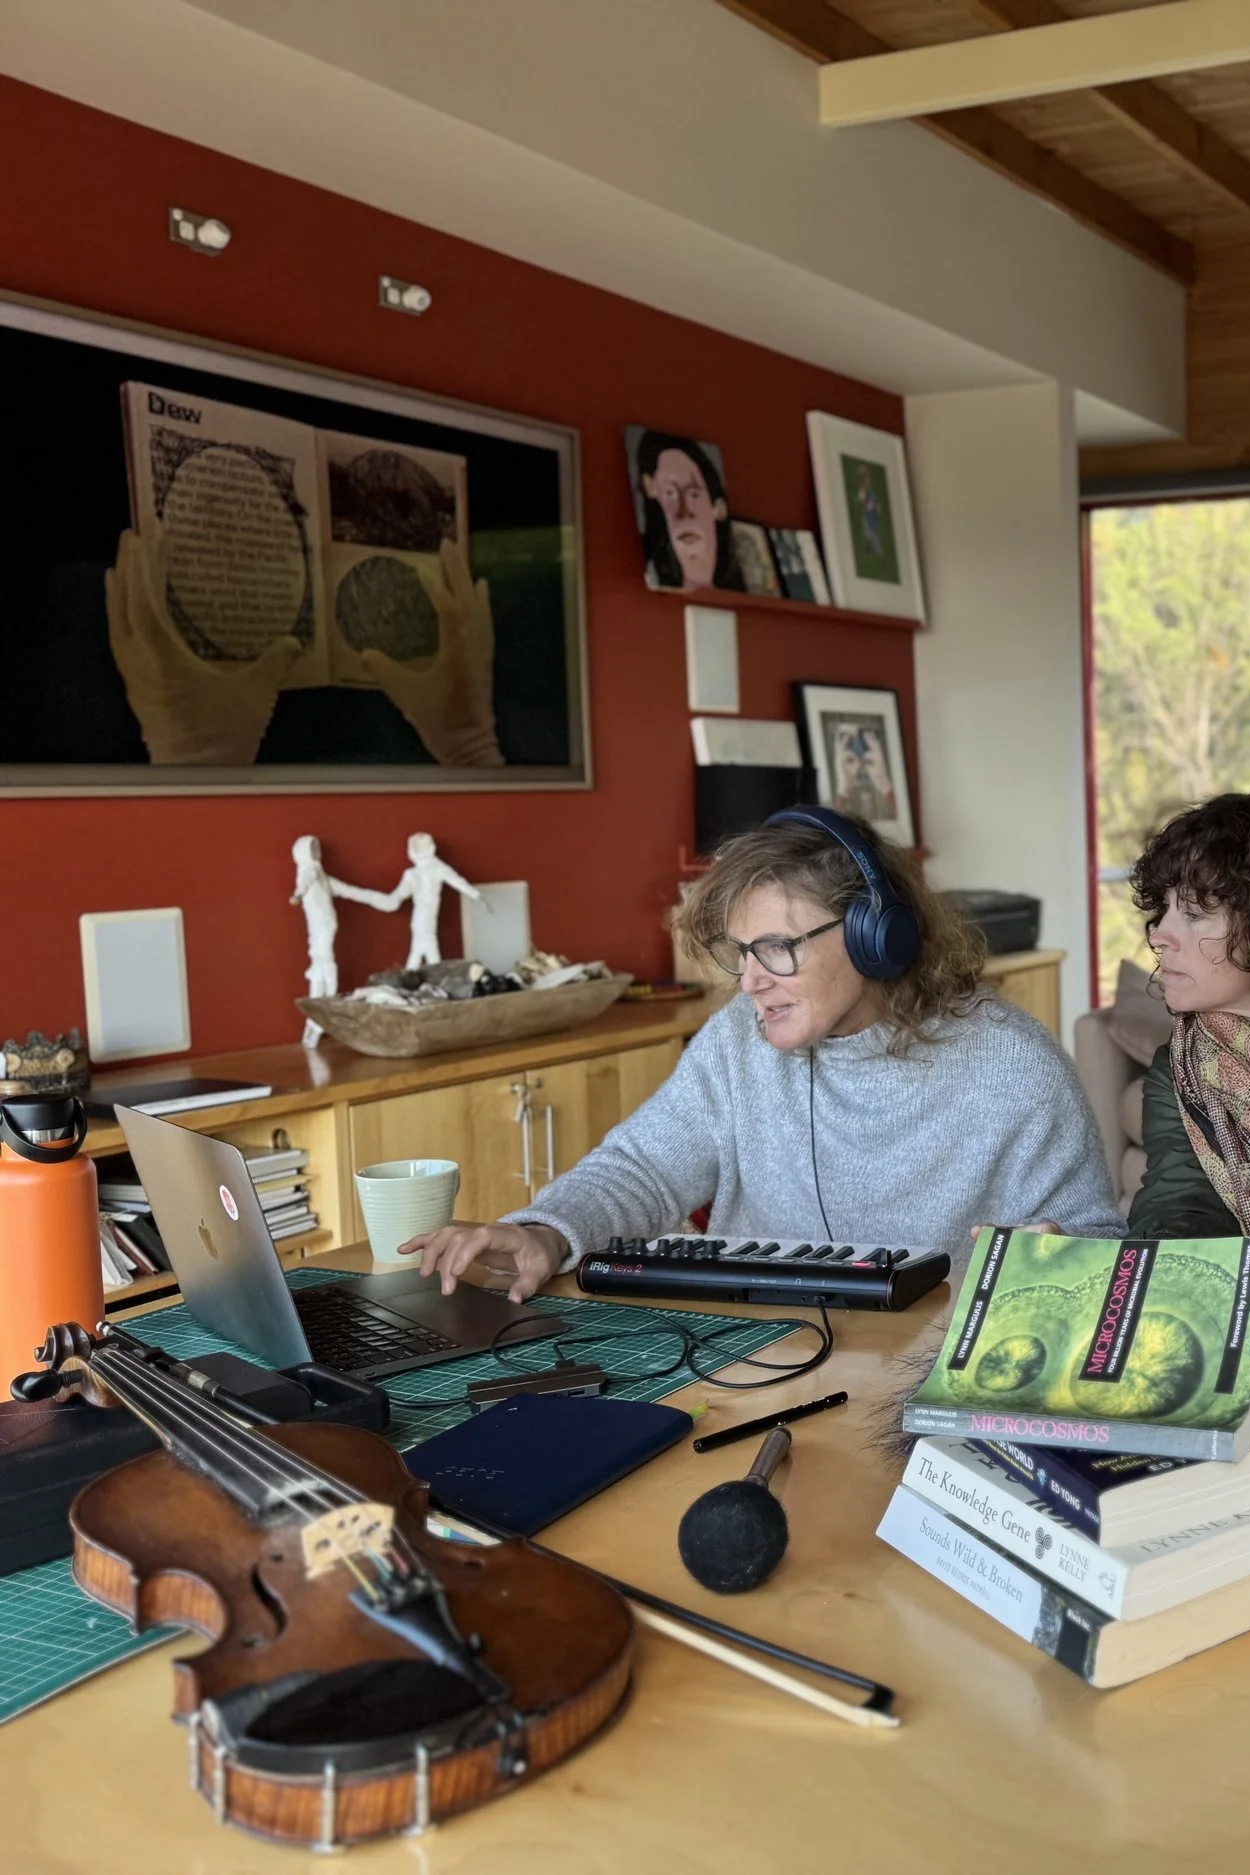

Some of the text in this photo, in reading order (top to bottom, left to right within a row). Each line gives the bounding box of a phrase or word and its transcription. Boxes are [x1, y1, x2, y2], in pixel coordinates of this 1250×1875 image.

[147, 391, 203, 424] Dew
[589, 1261, 611, 1275] iRig
[634, 1263, 643, 1273] 2
[981, 1234, 1005, 1290] DORION SAGAN
[1240, 1276, 1249, 1298] Lewis
[1087, 1249, 1137, 1374] MICROCOSMOS
[1107, 1248, 1149, 1374] FOUR BILLION YEARS OF MICROBIAL EVOLUTION
[1238, 1299, 1247, 1310] by
[957, 1300, 984, 1359] LYNN MARGULIS
[1230, 1311, 1244, 1349] Foreword
[914, 1407, 958, 1419] LYNN MARGULIS
[914, 1419, 956, 1430] DORION SAGAN
[968, 1413, 1110, 1444] MICROCOSMOS
[1008, 1441, 1034, 1471] WORLD
[1110, 1458, 1151, 1473] Hidden
[1148, 1462, 1174, 1472] ED
[918, 1457, 939, 1485] The
[939, 1471, 999, 1525] Knowledge
[1001, 1510, 1032, 1543] Gene
[1051, 1479, 1081, 1511] ED YONG
[1140, 1520, 1228, 1554] LYNNE
[919, 1516, 1024, 1604] Sounds Wild & Broken
[936, 1556, 952, 1574] DAVID
[951, 1566, 971, 1586] GEORGE
[1058, 1558, 1087, 1584] KELLY
[1059, 1543, 1090, 1571] LYNNE
